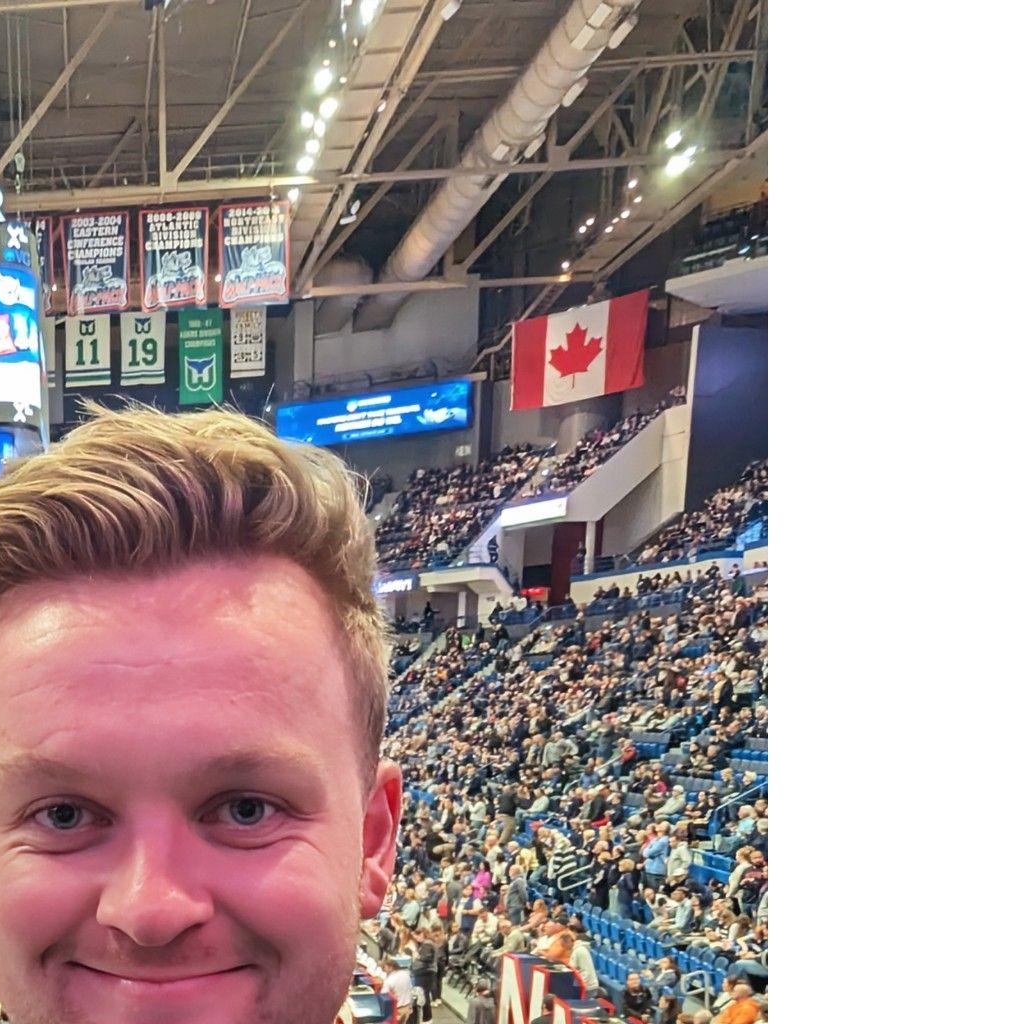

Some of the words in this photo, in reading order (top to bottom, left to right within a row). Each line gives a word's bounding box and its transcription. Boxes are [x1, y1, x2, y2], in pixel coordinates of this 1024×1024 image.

[72, 215, 122, 228] 2003-2004
[149, 220, 199, 232] ATLANTIC
[73, 226, 118, 237] EASTERN
[152, 230, 197, 241] DIVISION
[145, 239, 203, 251] CHAMPIONS
[76, 339, 100, 365] 11
[129, 338, 158, 366] 19
